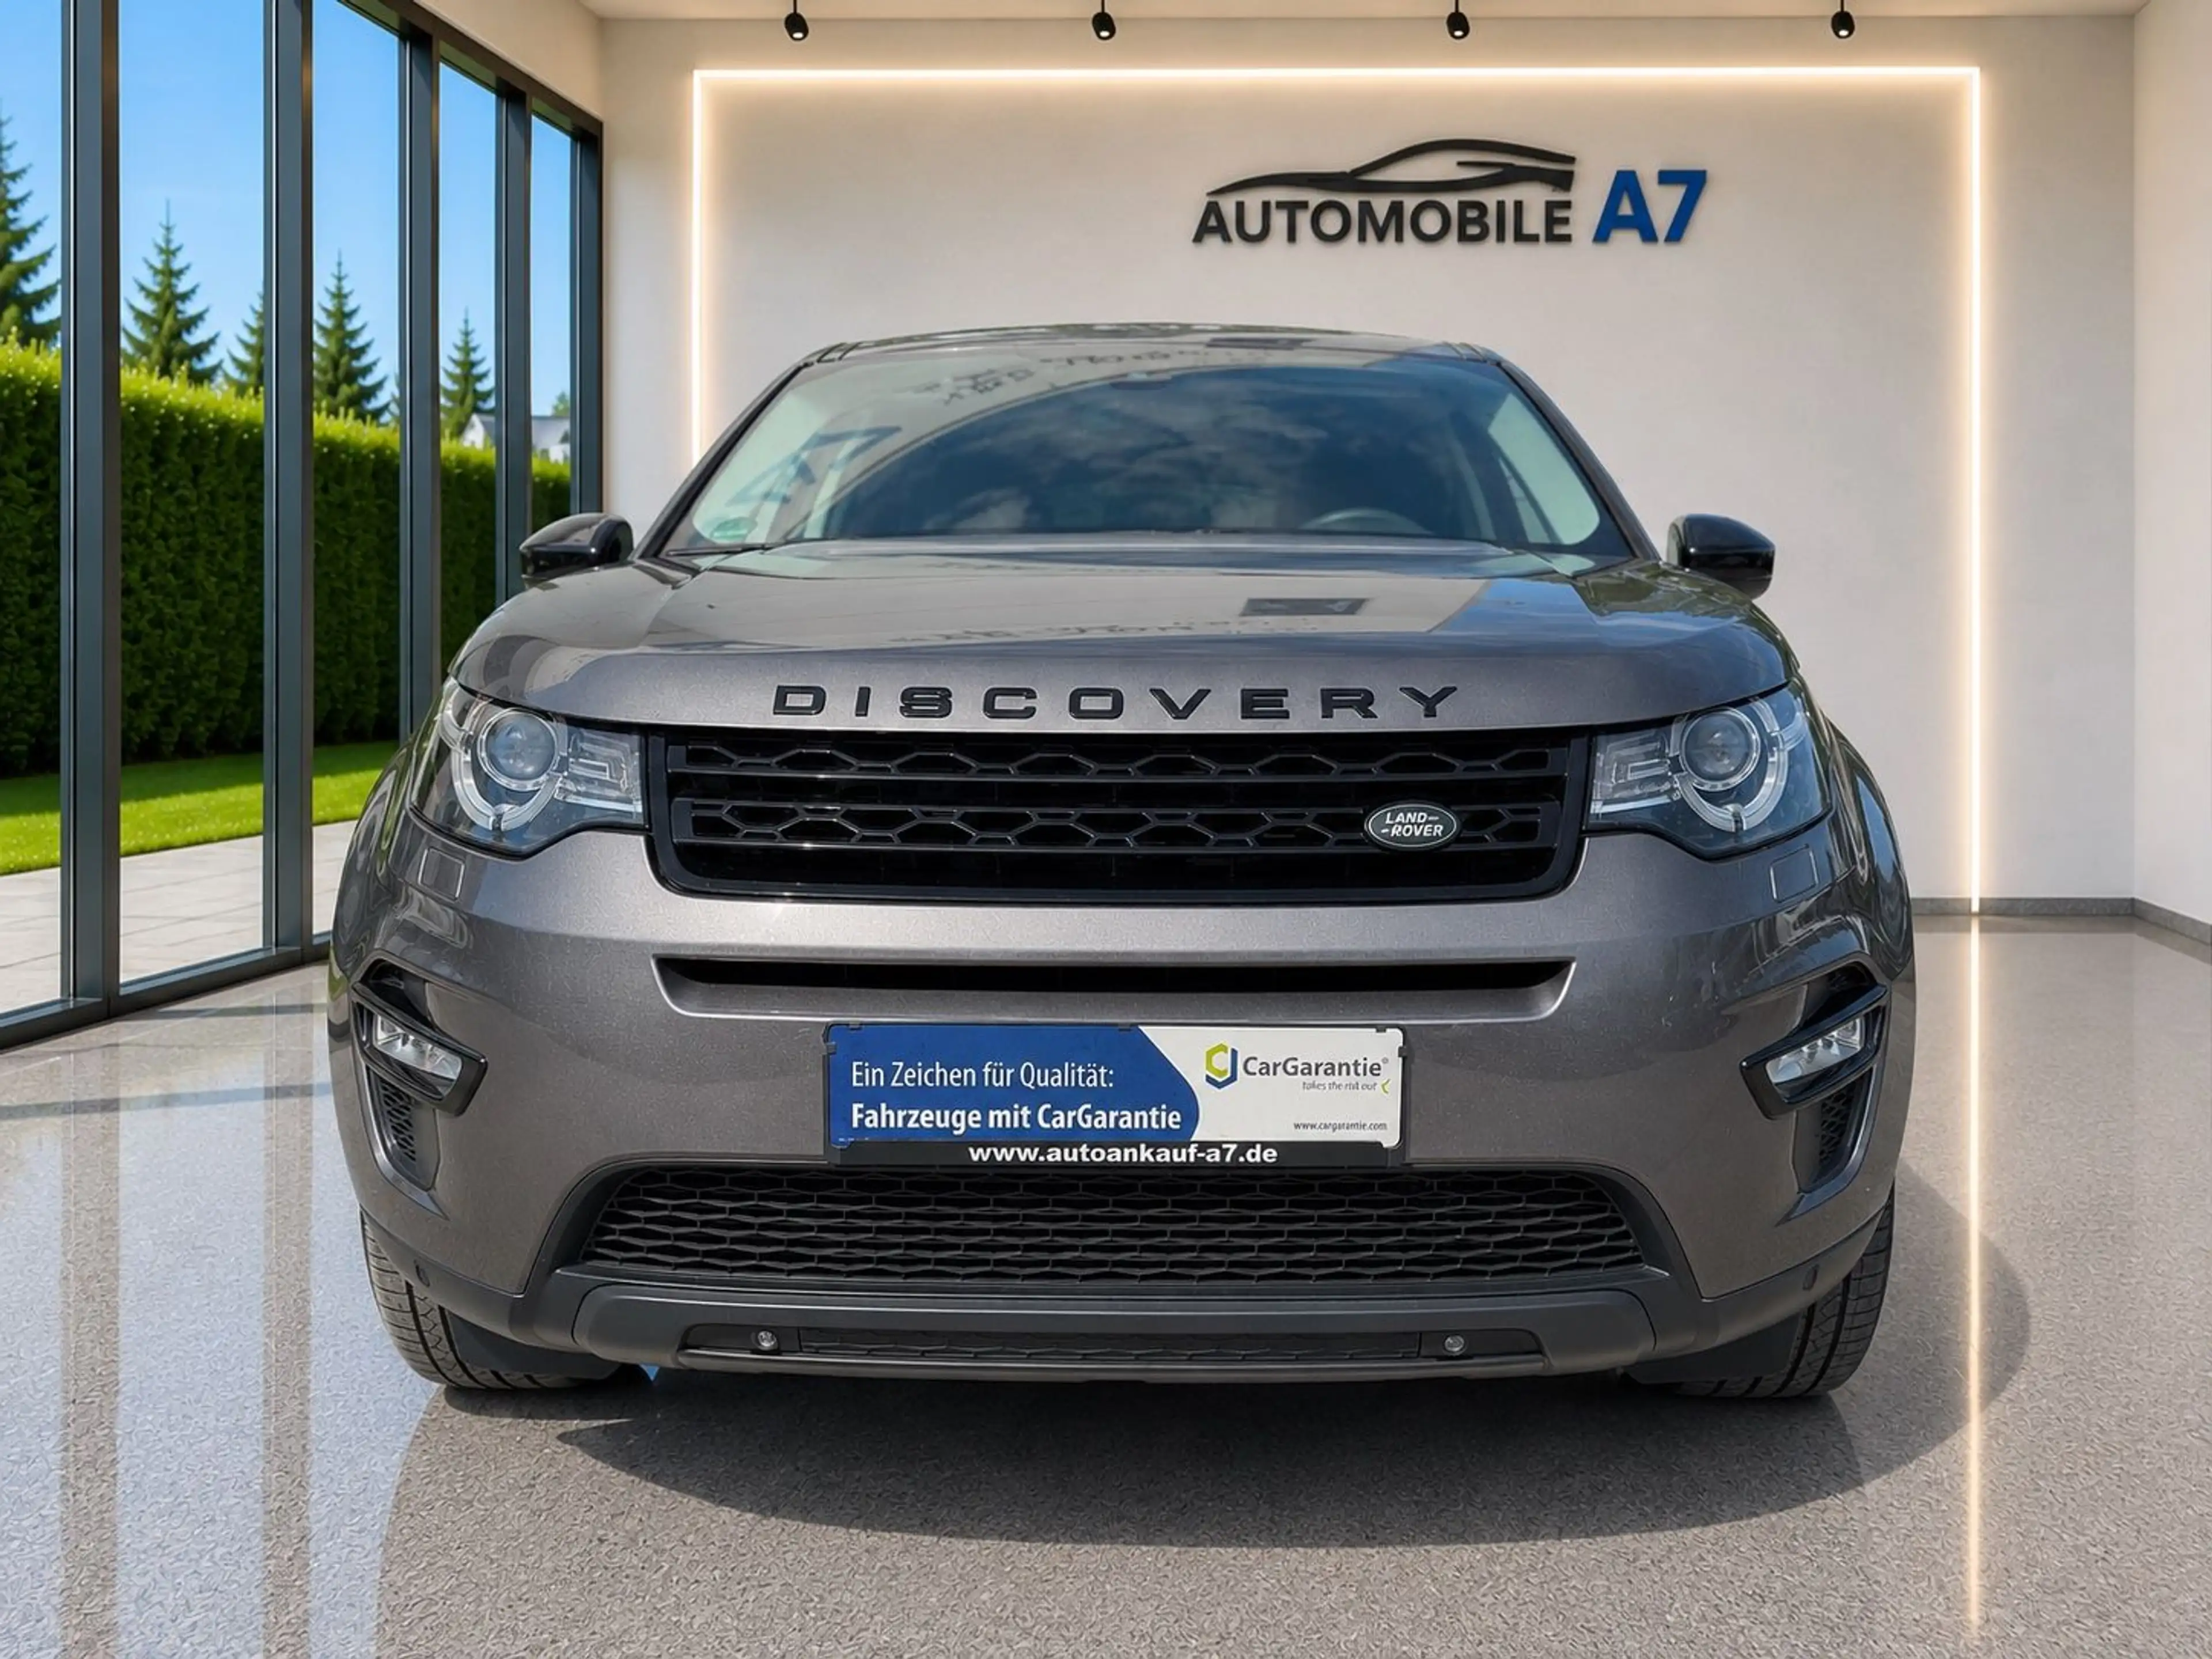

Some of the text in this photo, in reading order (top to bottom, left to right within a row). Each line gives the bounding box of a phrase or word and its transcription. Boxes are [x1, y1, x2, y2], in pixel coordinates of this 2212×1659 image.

[1192, 169, 1707, 244] AUTOMOBILE A7
[772, 685, 1458, 719] DISCOVERY
[852, 1061, 1114, 1089] Ein Zeichen für Qualität:
[851, 1103, 1181, 1135] Fahrzeuge mit CarGarantie
[968, 1143, 1278, 1163] www.autoankauf-a7.de
